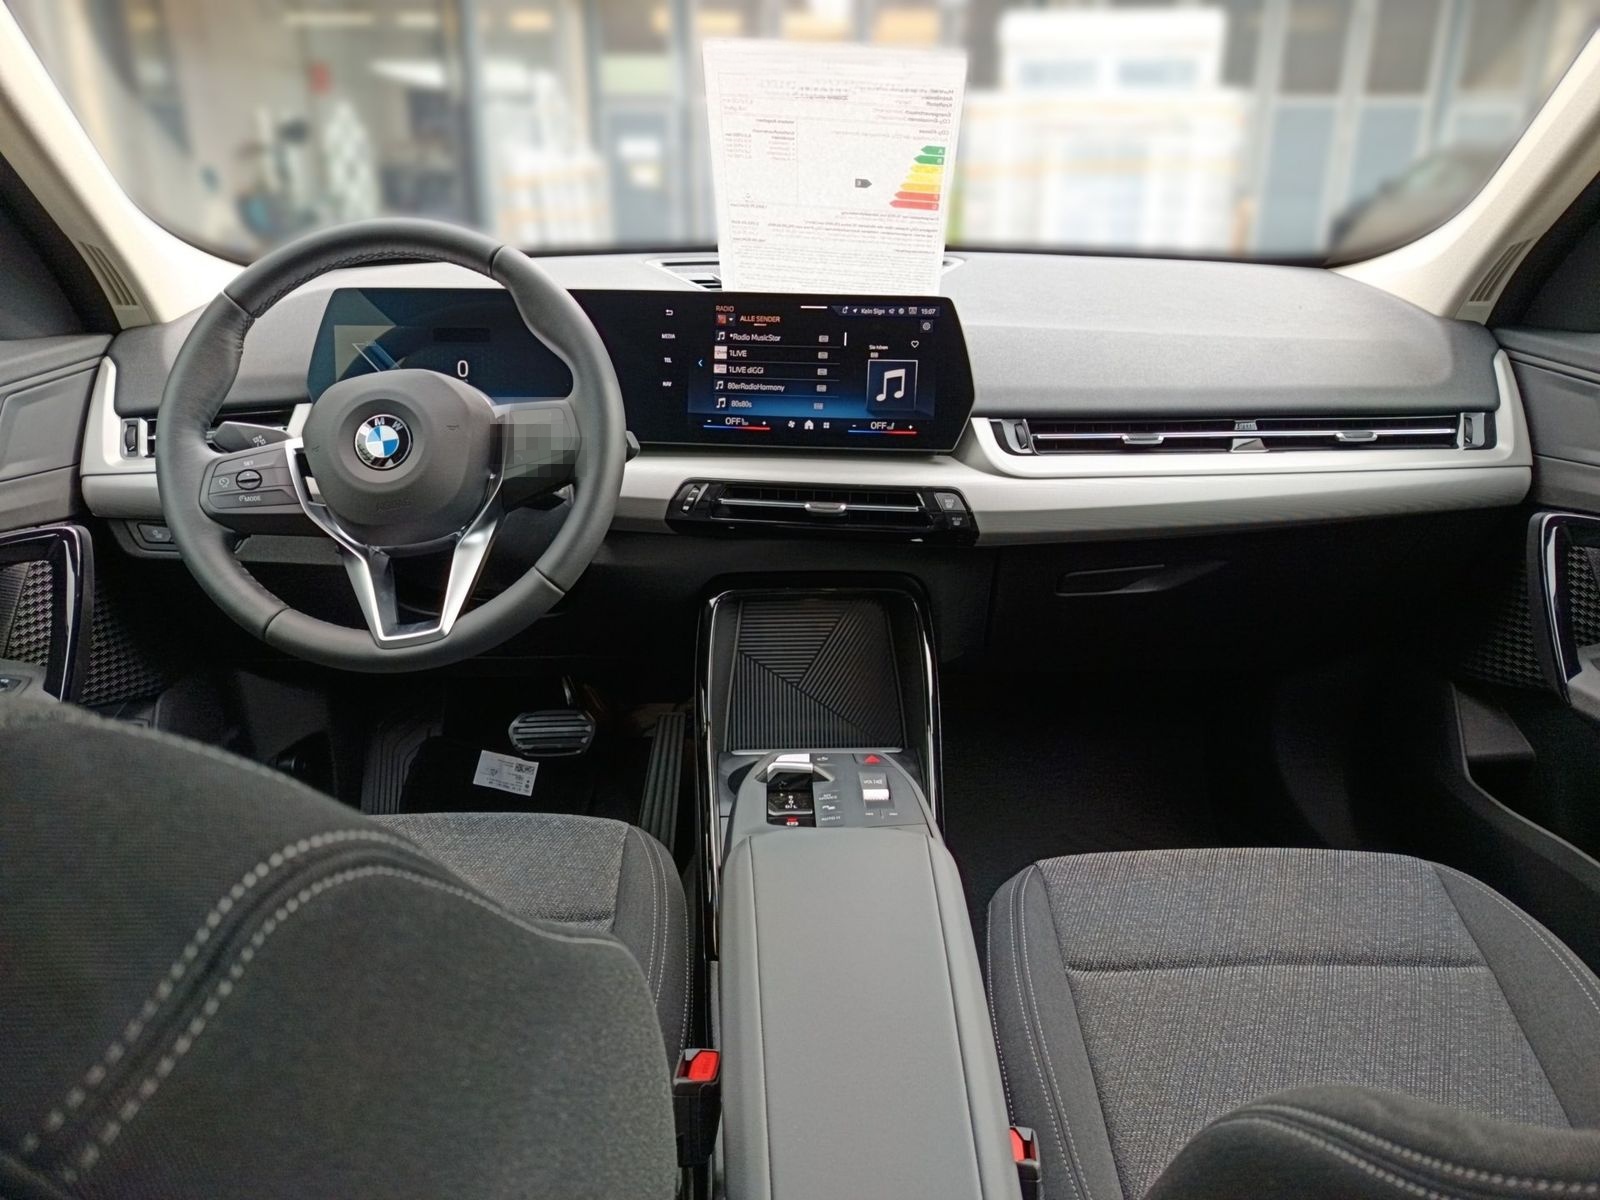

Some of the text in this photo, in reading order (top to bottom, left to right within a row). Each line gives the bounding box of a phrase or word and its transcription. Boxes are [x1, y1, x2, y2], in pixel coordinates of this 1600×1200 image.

[751, 334, 781, 342] MusicStar
[729, 349, 748, 357] 1LIVE
[457, 360, 469, 378] 0
[728, 366, 747, 374] 1LIVE
[727, 383, 785, 392] 80erRadioHarmony
[725, 417, 741, 425] OFF
[870, 421, 887, 430] OFF
